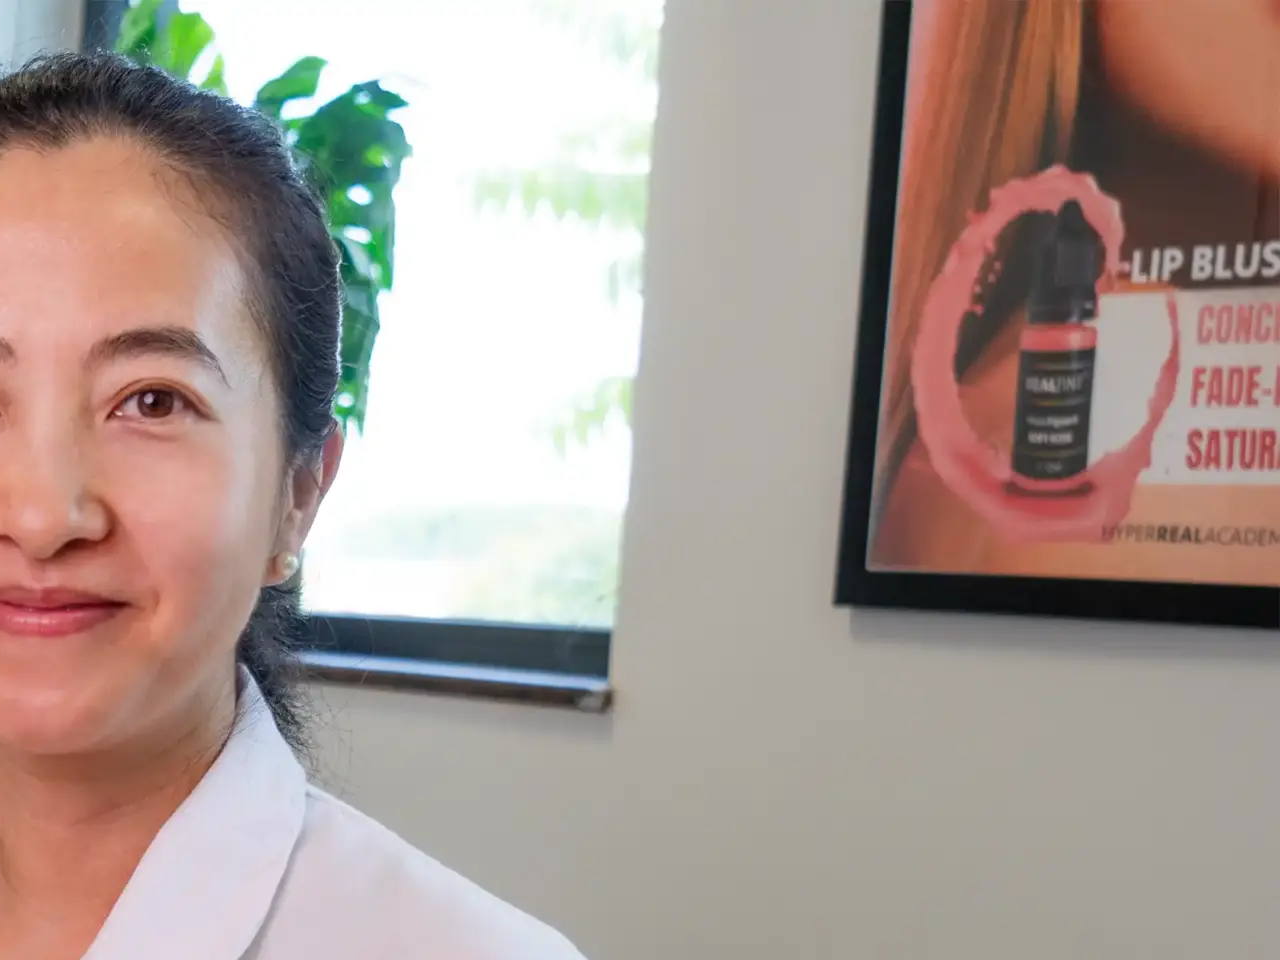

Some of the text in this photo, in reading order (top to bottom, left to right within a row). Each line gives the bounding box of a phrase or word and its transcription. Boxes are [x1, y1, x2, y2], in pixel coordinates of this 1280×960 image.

[1190, 240, 1280, 281] BLUS
[1196, 303, 1280, 345] CONC
[1185, 428, 1280, 471] SATUR
